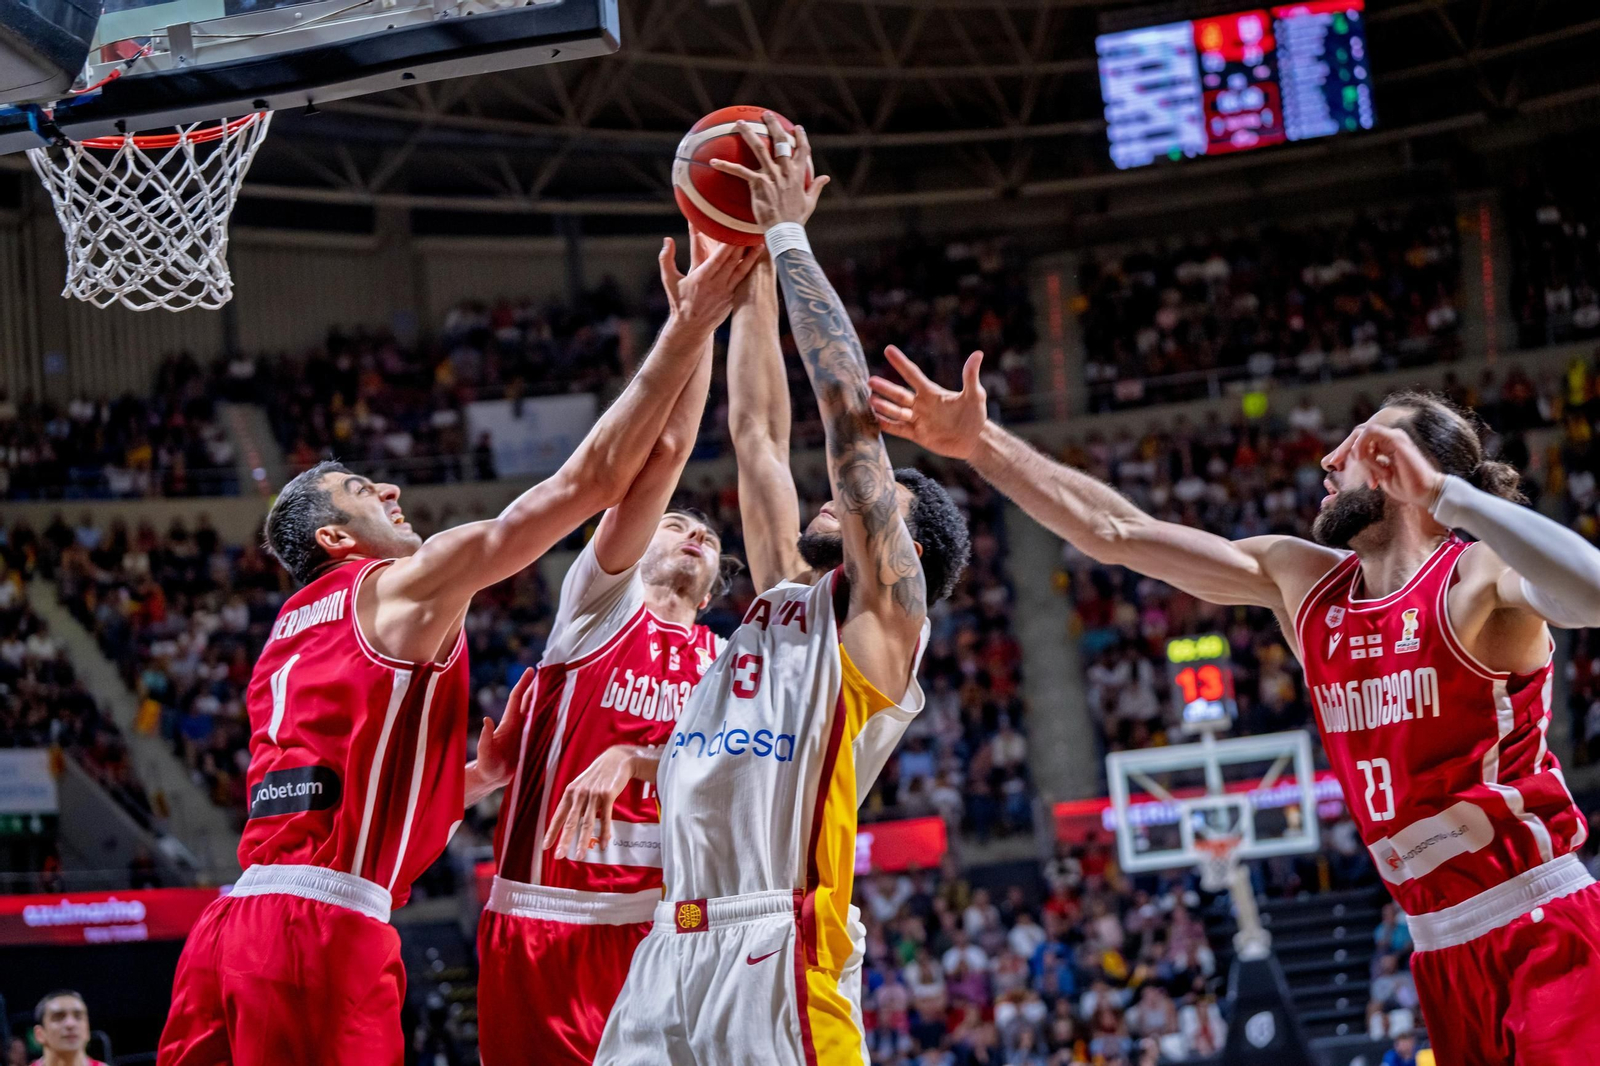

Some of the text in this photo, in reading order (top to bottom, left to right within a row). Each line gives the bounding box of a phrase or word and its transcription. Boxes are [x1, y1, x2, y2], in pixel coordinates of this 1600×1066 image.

[268, 653, 300, 746] 1
[1175, 664, 1224, 703] 13
[1356, 757, 1396, 822] 23
